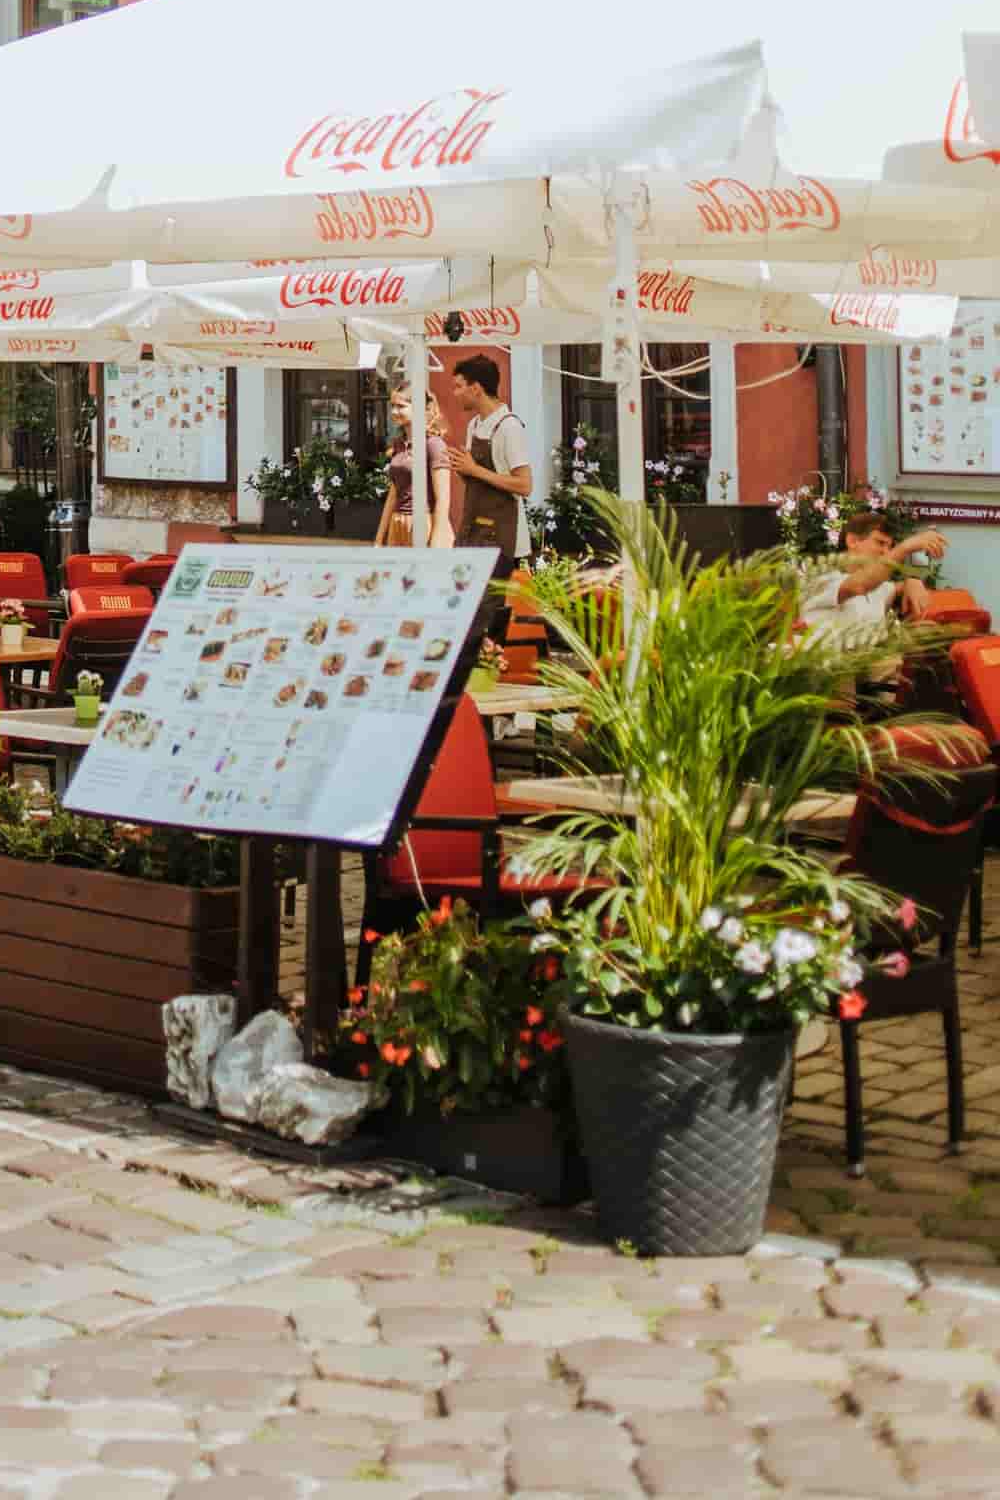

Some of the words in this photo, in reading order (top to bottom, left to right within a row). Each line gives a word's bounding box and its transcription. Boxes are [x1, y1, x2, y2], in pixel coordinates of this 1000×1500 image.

[284, 88, 507, 178] Coca-Cola
[280, 268, 405, 309] Coca-Cola
[637, 268, 698, 316] ca-Cola
